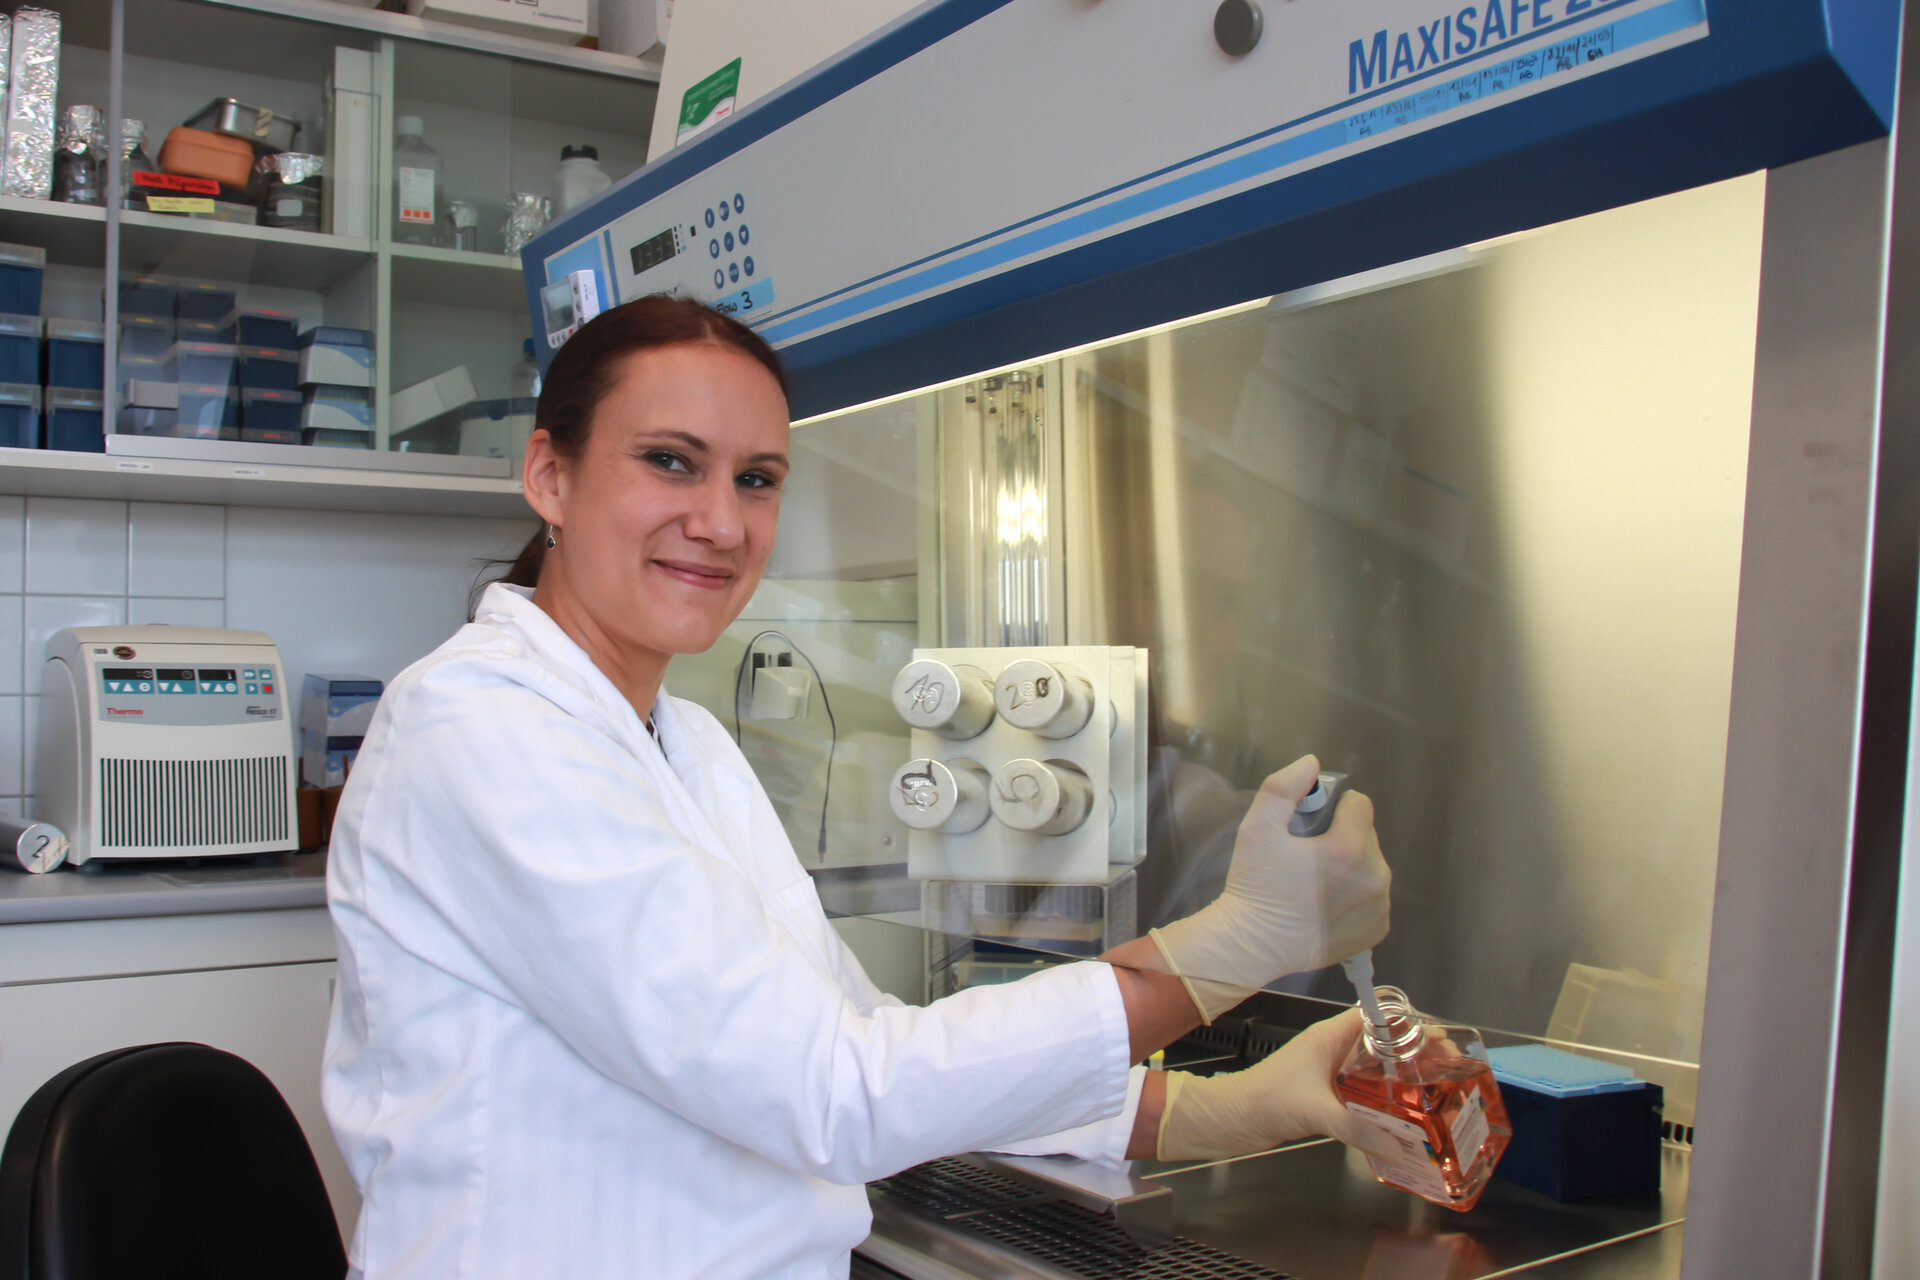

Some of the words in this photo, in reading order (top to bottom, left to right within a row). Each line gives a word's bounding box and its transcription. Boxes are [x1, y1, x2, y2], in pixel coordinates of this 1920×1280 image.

[741, 291, 753, 310] 3
[106, 707, 144, 716] Thermo
[31, 834, 50, 858] 2
